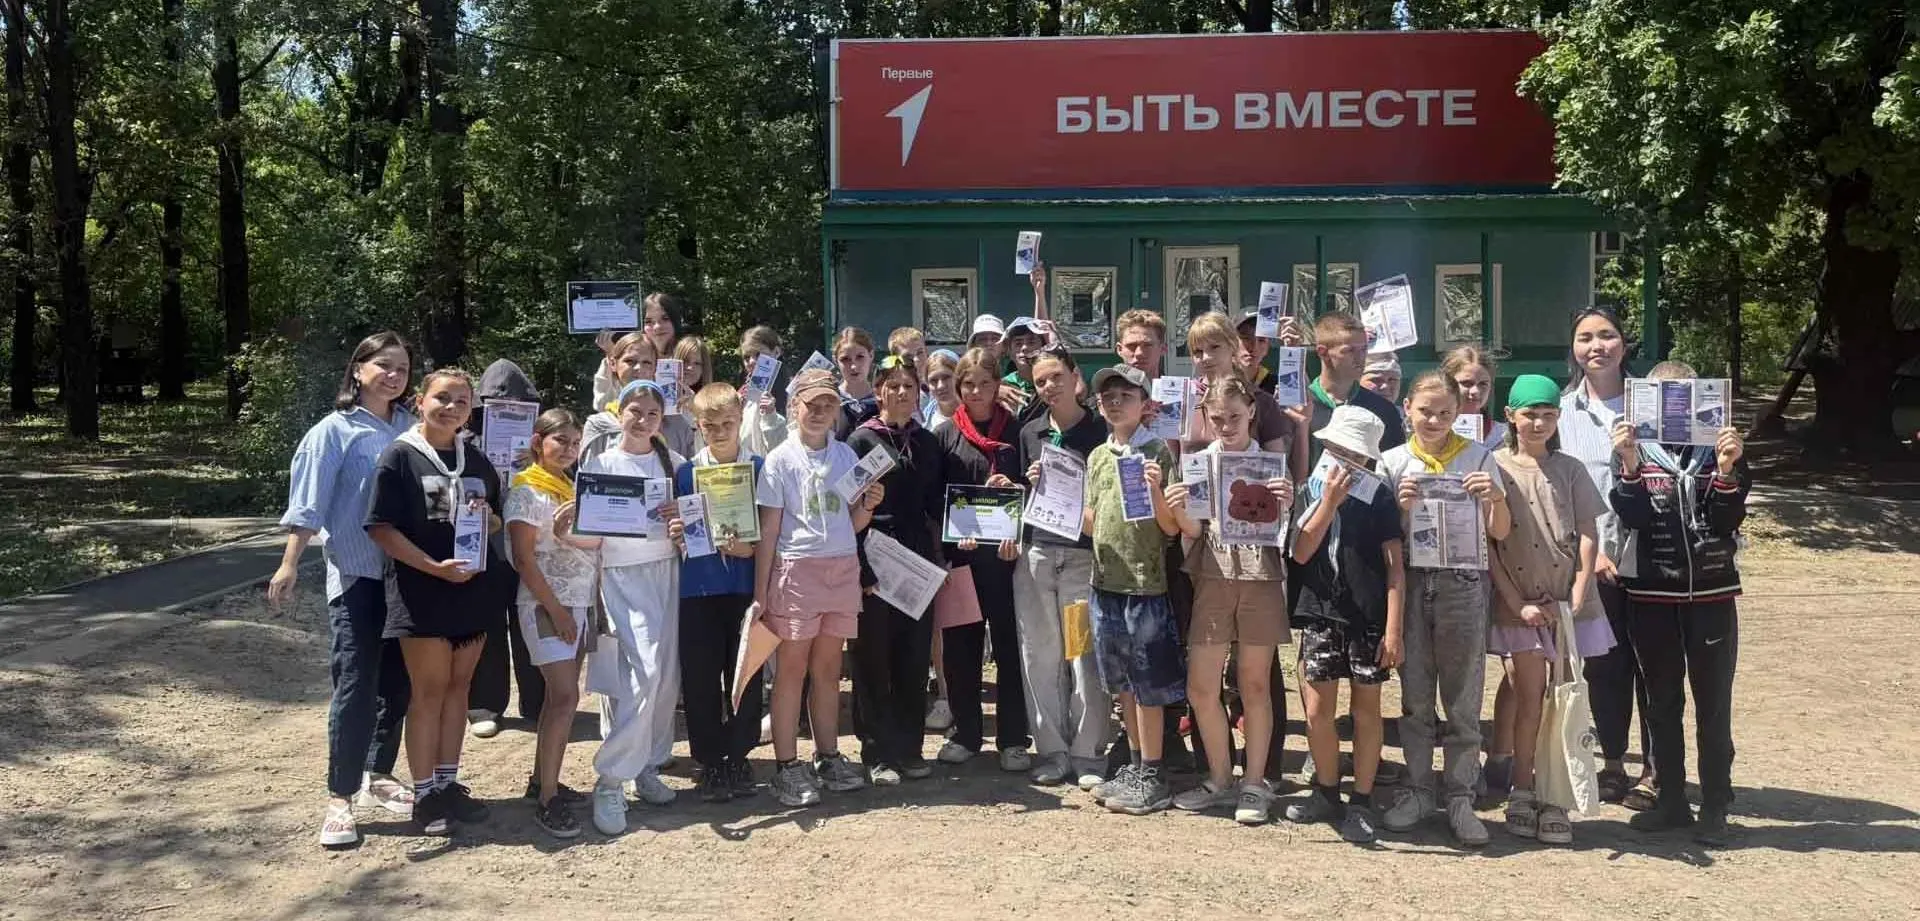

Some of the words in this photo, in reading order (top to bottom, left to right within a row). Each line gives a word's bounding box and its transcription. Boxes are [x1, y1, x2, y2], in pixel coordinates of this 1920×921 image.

[881, 67, 934, 83] Первые
[1056, 94, 1221, 134] БЫТЬ
[1233, 88, 1478, 131] ВМЕСТЕ
